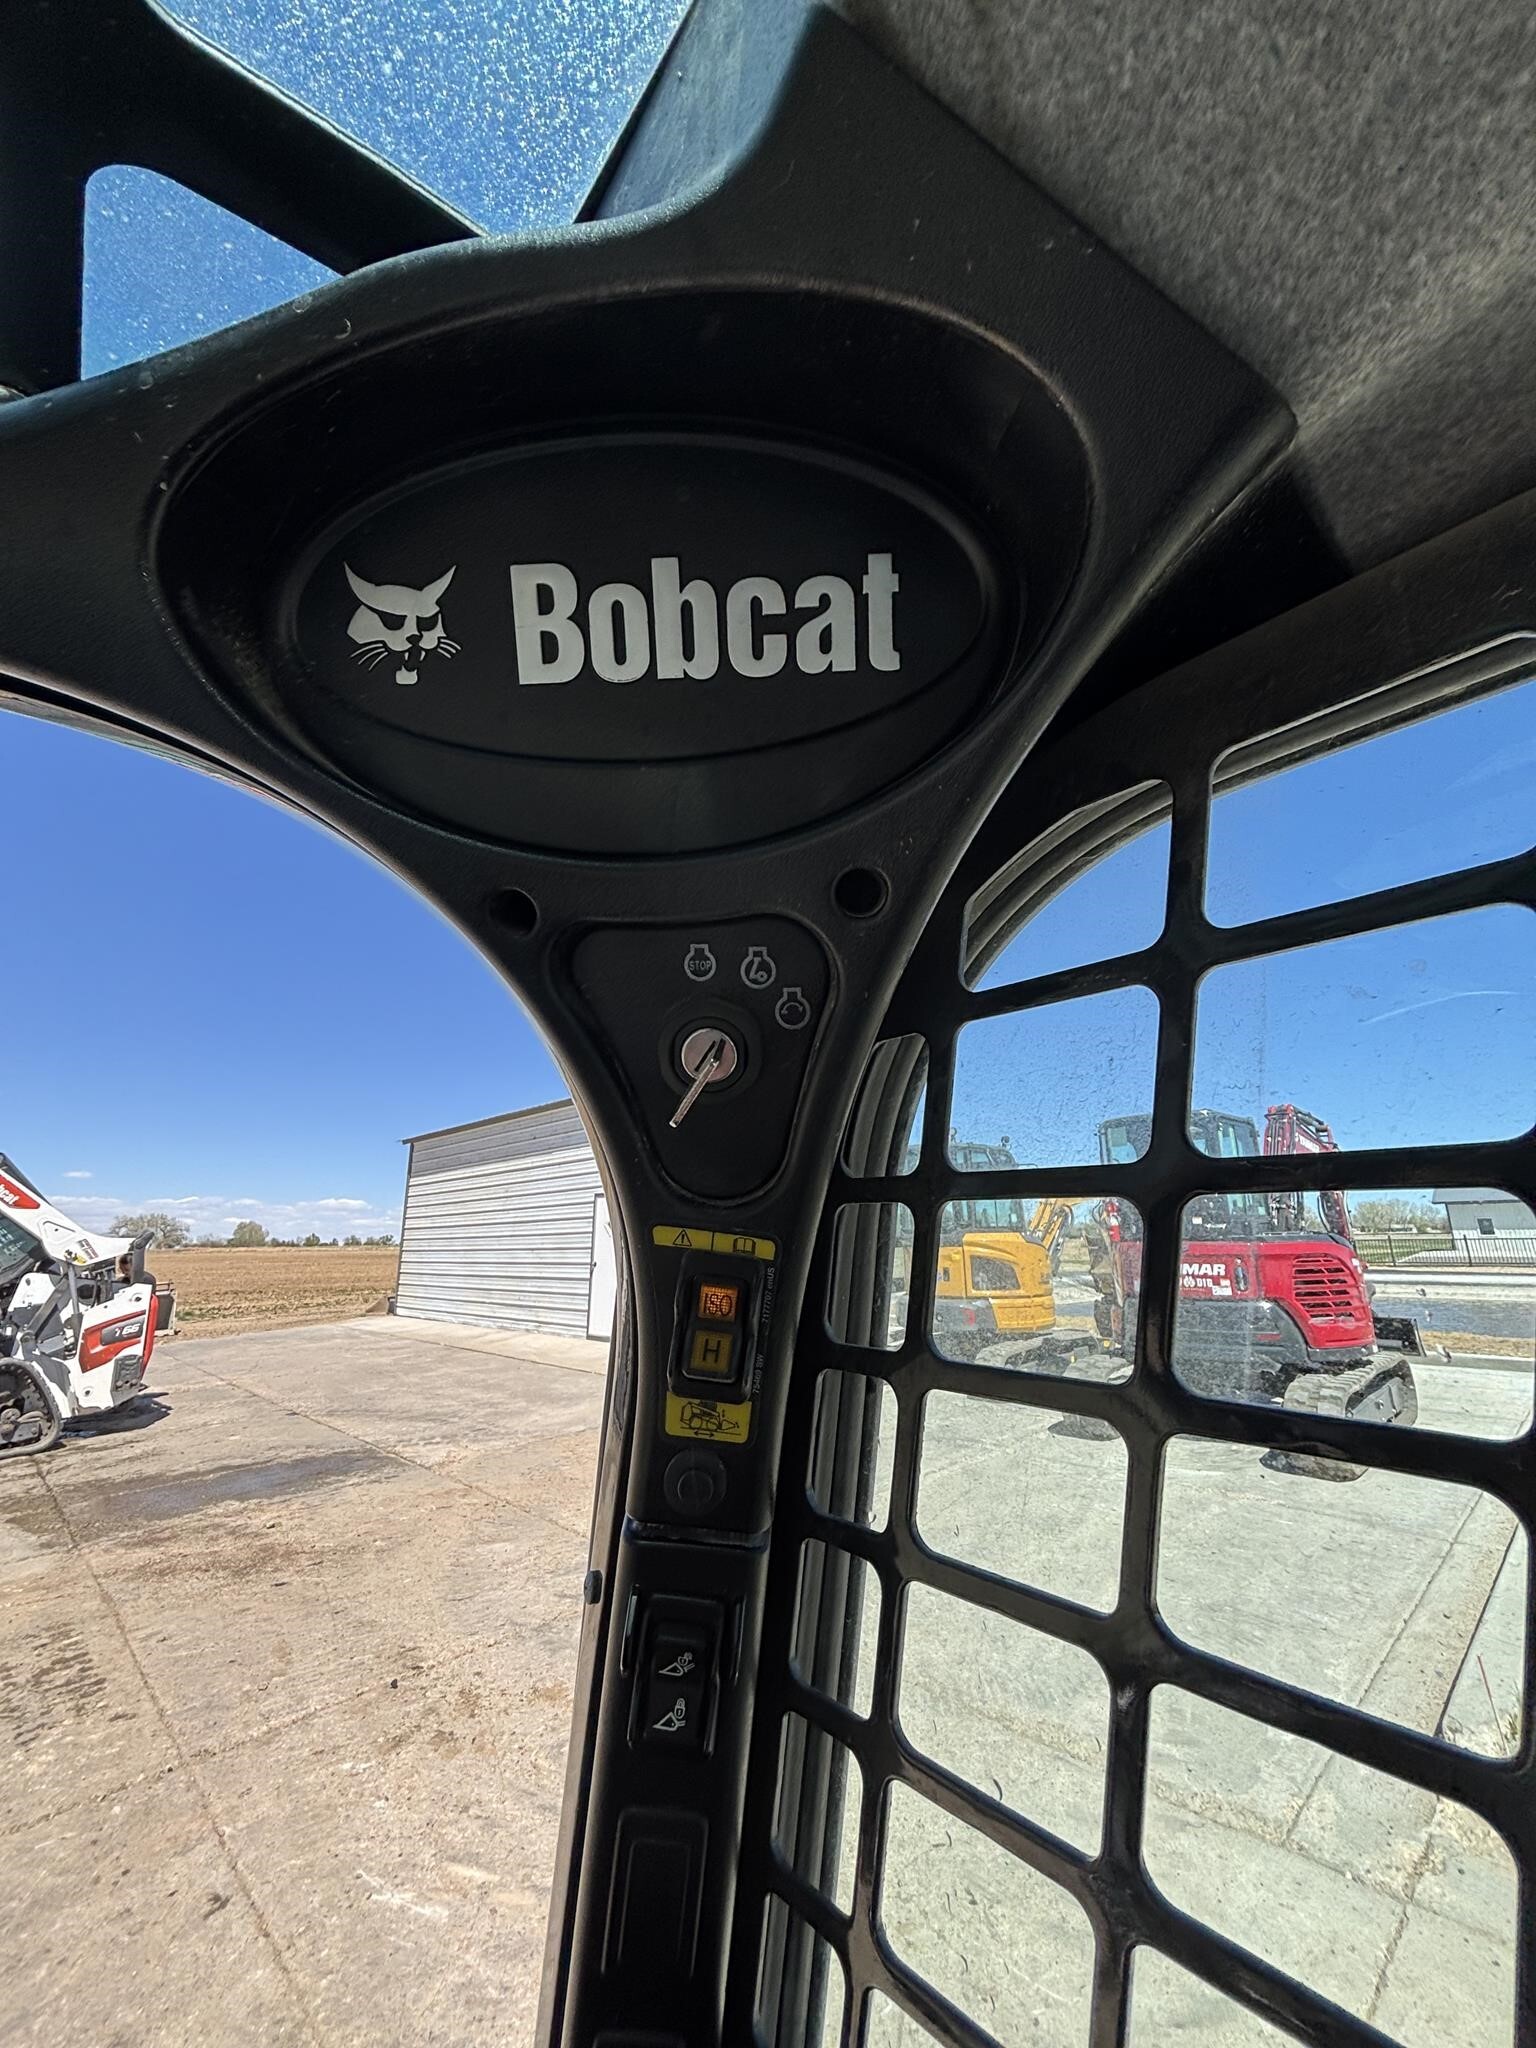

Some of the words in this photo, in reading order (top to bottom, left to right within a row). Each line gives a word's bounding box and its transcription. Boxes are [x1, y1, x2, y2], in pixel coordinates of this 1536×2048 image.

[510, 553, 900, 685] Bobcat
[688, 960, 711, 972] STOP
[704, 1293, 732, 1316] ISO
[702, 1338, 721, 1364] H
